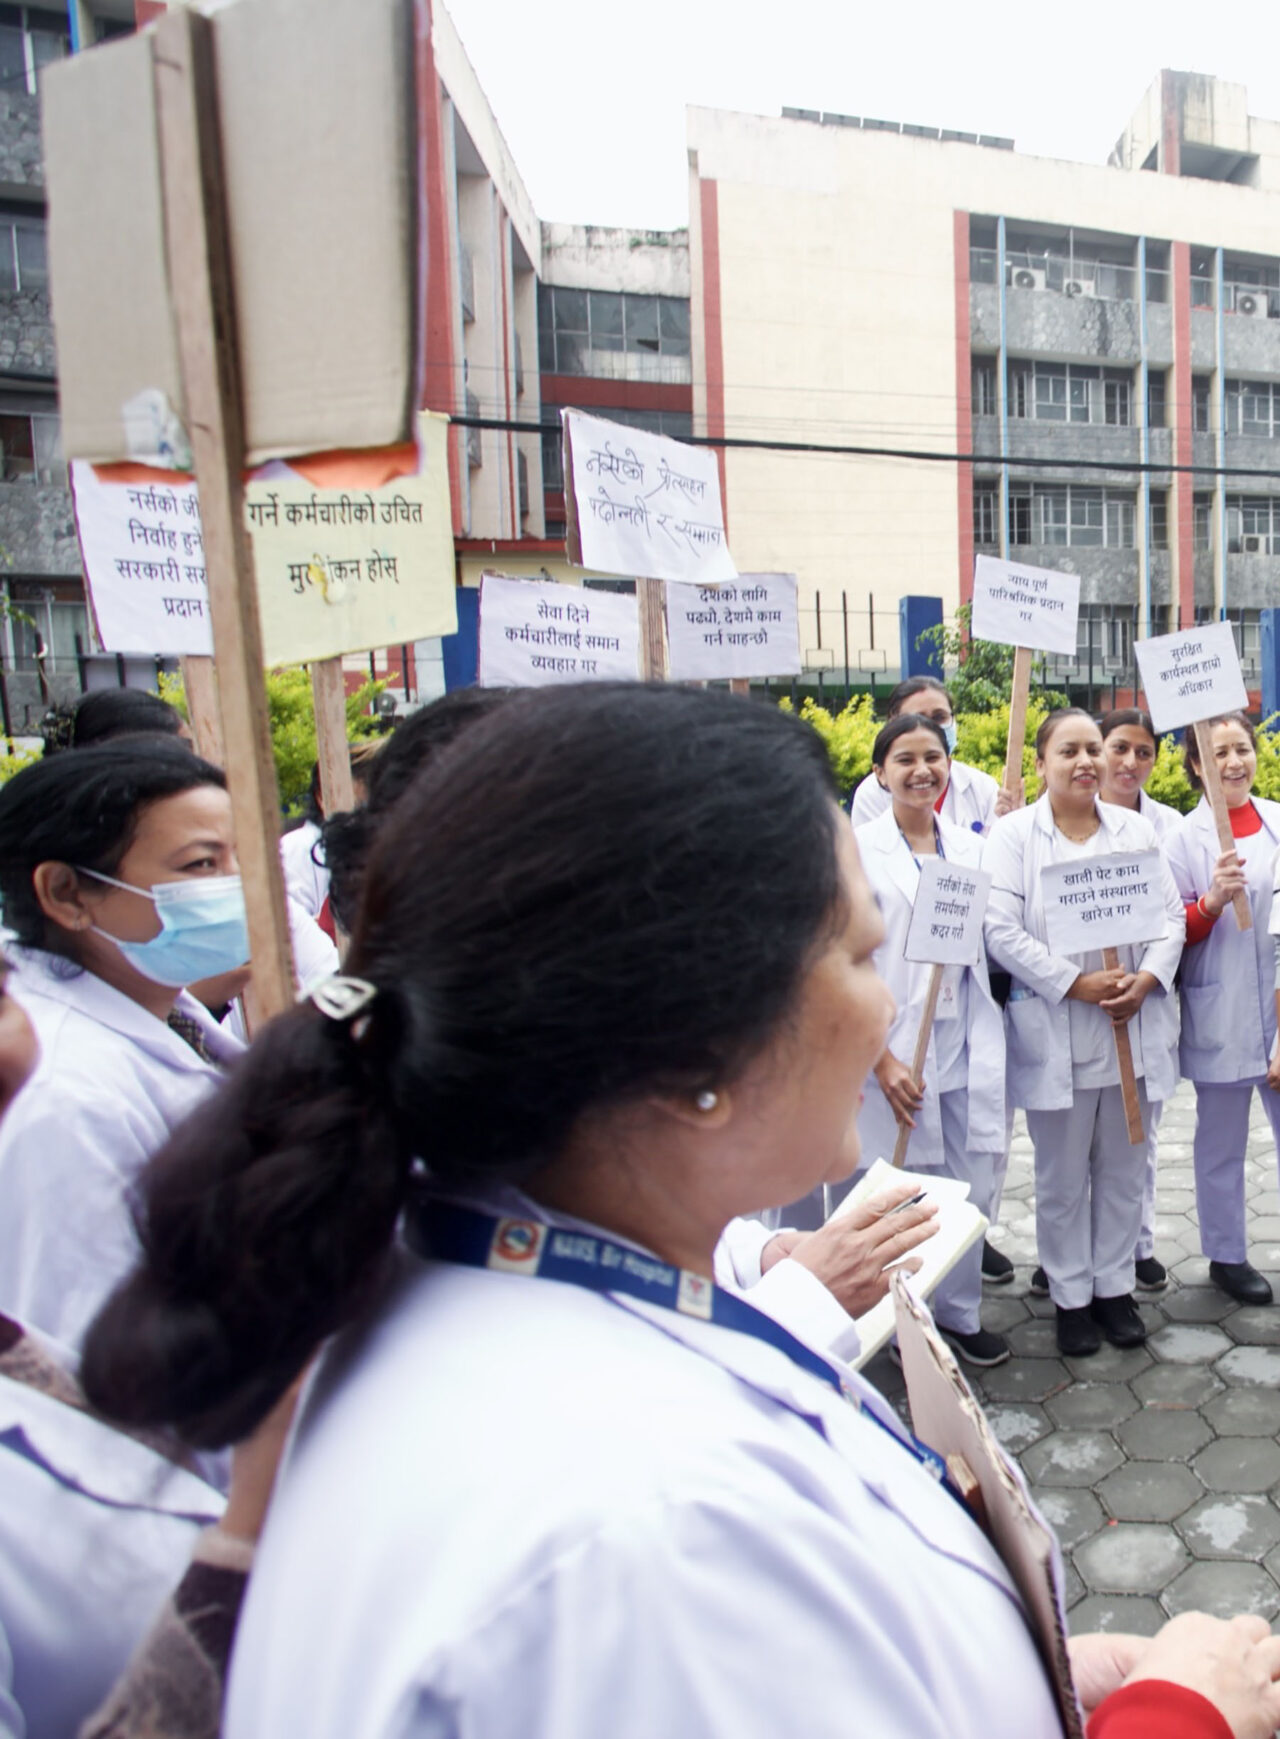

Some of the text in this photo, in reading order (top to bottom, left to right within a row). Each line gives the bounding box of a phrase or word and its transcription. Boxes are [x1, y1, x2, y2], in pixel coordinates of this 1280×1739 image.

[127, 486, 178, 514] नर्सको
[284, 493, 375, 526] कर्मचारीको
[380, 495, 423, 524] उचित
[129, 518, 177, 550] निर्वाह
[656, 514, 681, 548] र
[114, 557, 181, 582] सरकारी
[366, 549, 400, 584] होस्
[741, 585, 769, 602] लागि
[162, 597, 203, 618] प्रदान
[537, 600, 590, 623] सेवा दिने
[1040, 599, 1064, 611] प्रदान
[757, 610, 782, 623] काम
[504, 622, 620, 651] कर्मचारीलाई समान
[703, 629, 723, 646] गर्न
[1170, 642, 1203, 662] सुरक्षित
[531, 654, 598, 674] व्यवहार गर
[1178, 679, 1214, 697] अधिकार
[937, 874, 961, 894] नर्सको
[1063, 864, 1140, 886] खाली पेट काम
[1059, 887, 1095, 906] गराउने
[1080, 904, 1131, 922] खारेज गर
[931, 923, 950, 939] कदर
